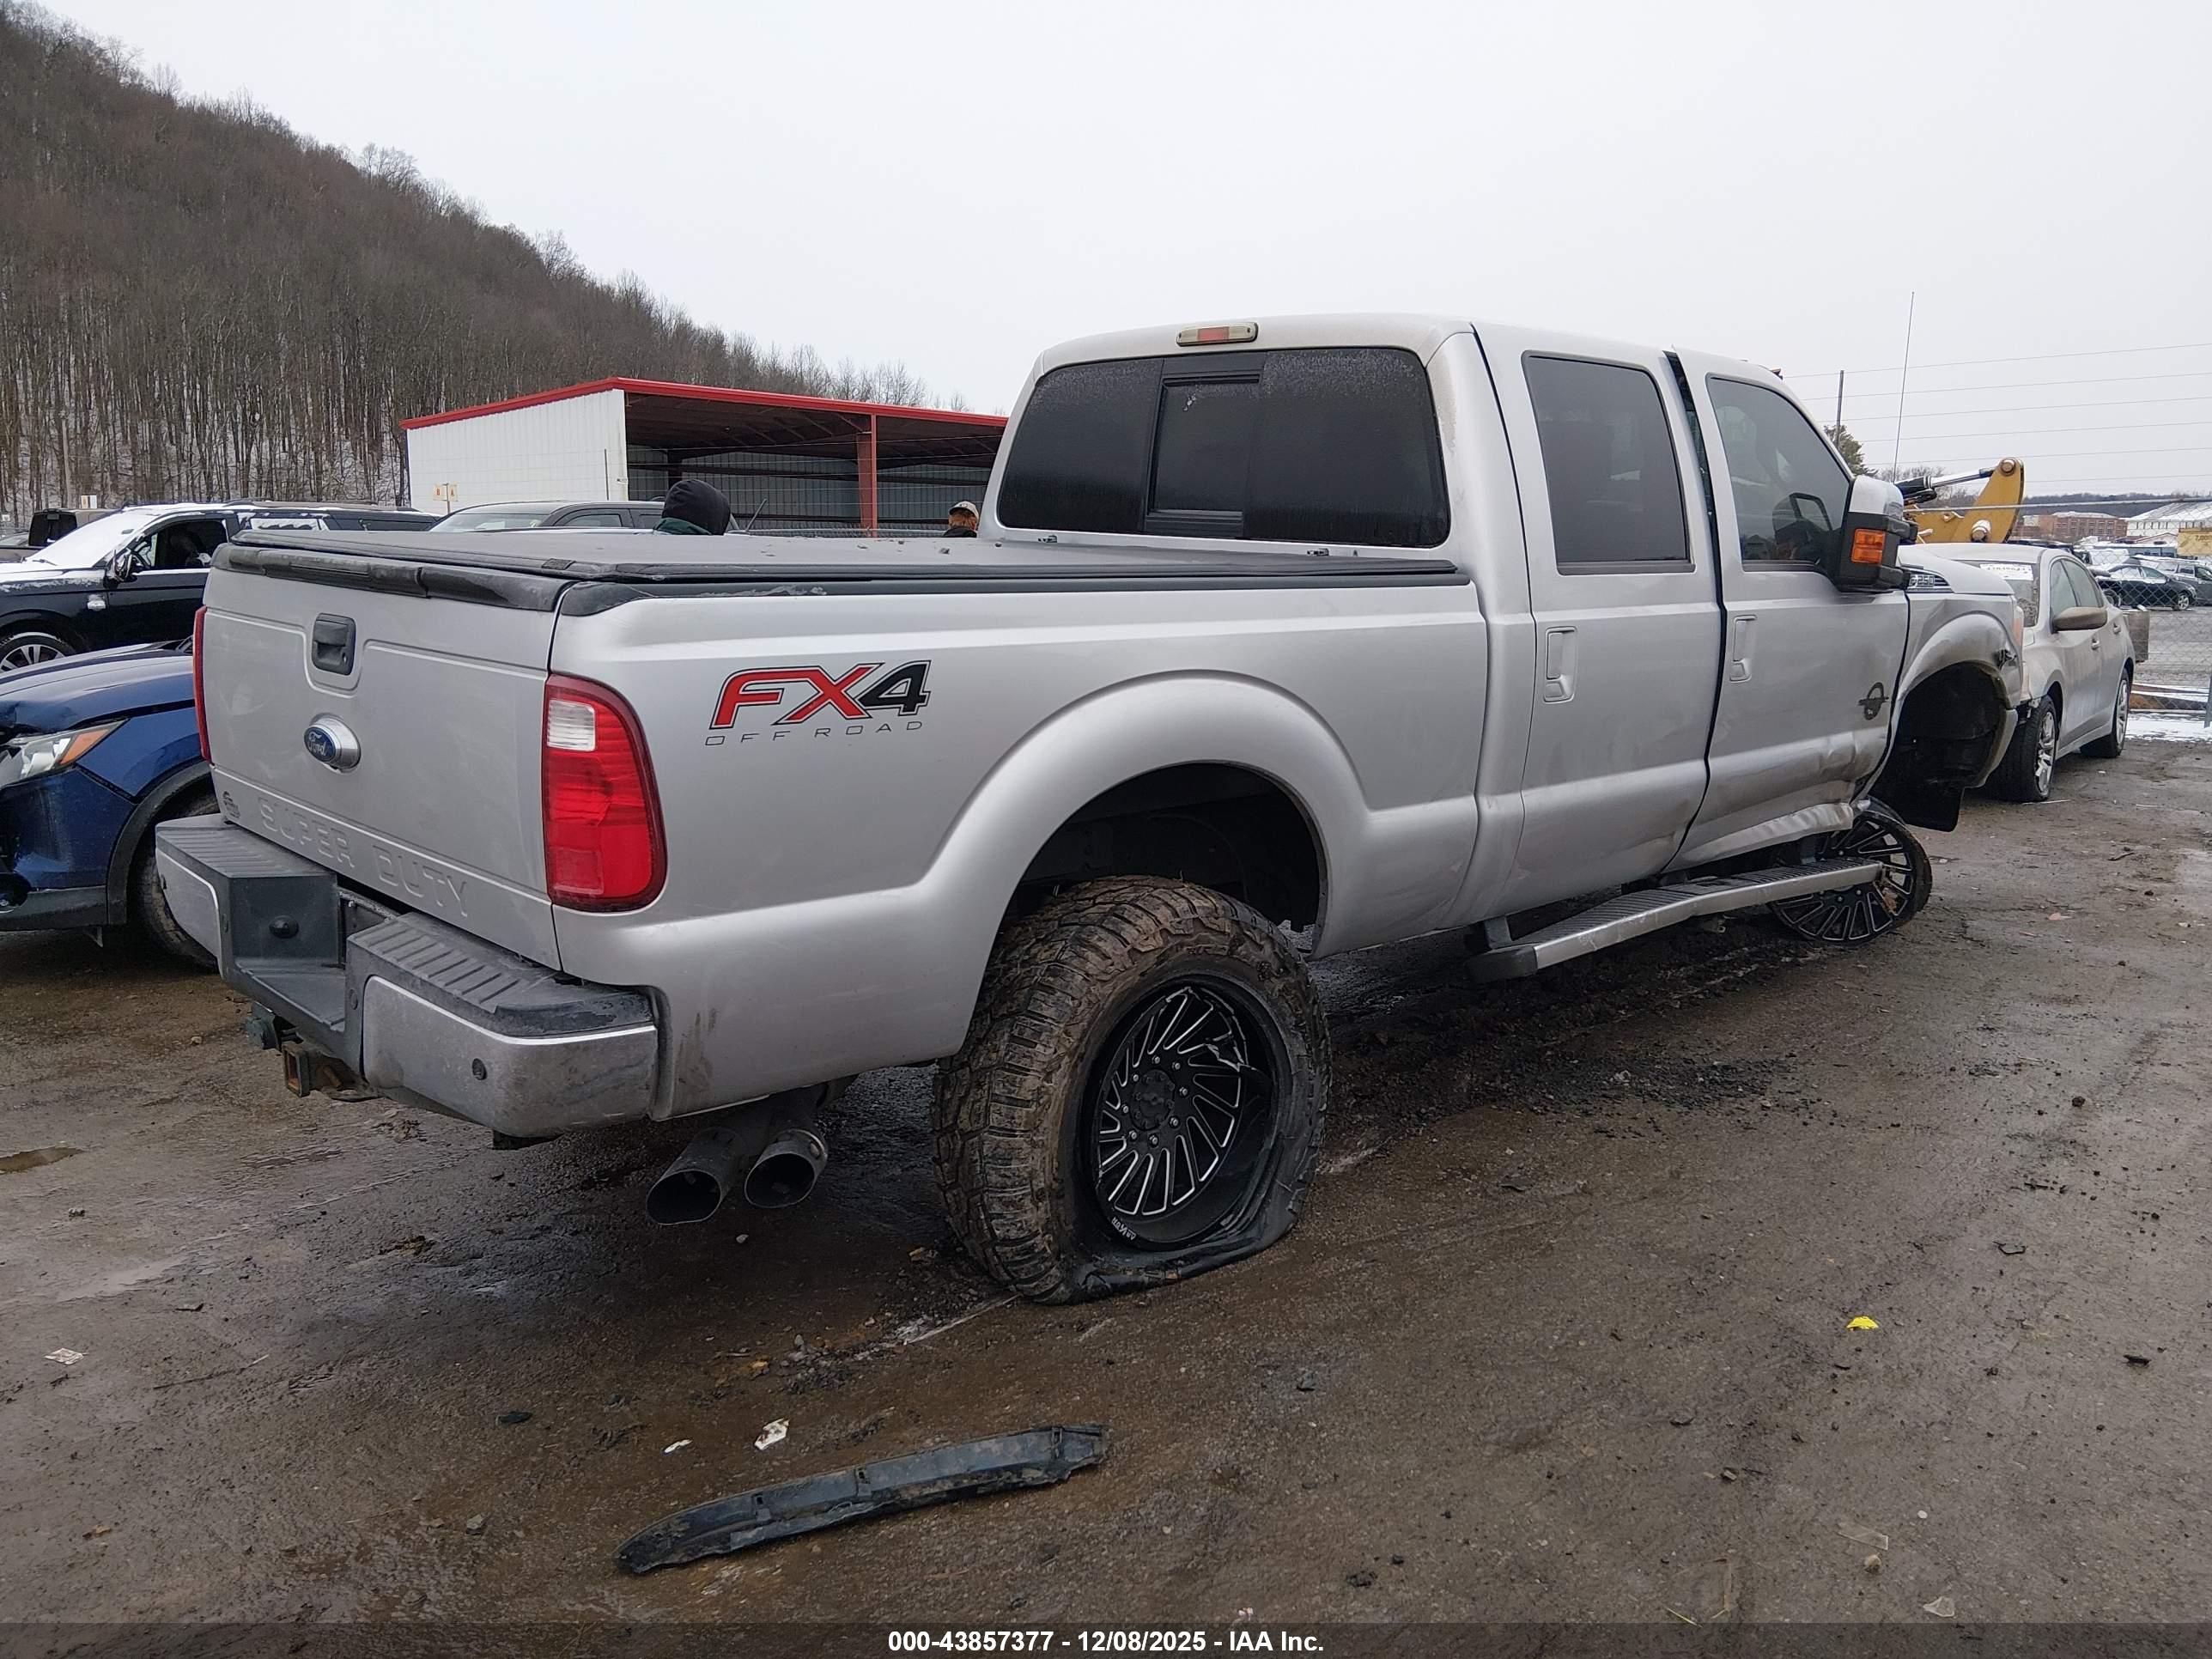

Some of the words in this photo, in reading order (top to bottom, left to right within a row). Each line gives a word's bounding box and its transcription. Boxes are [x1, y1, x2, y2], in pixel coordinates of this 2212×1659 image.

[708, 659, 933, 730] FX4
[307, 731, 327, 757] Ford
[704, 731, 791, 746] OFF
[814, 721, 923, 738] ROAD
[258, 797, 356, 869] SUPER
[373, 845, 467, 918] DUTY
